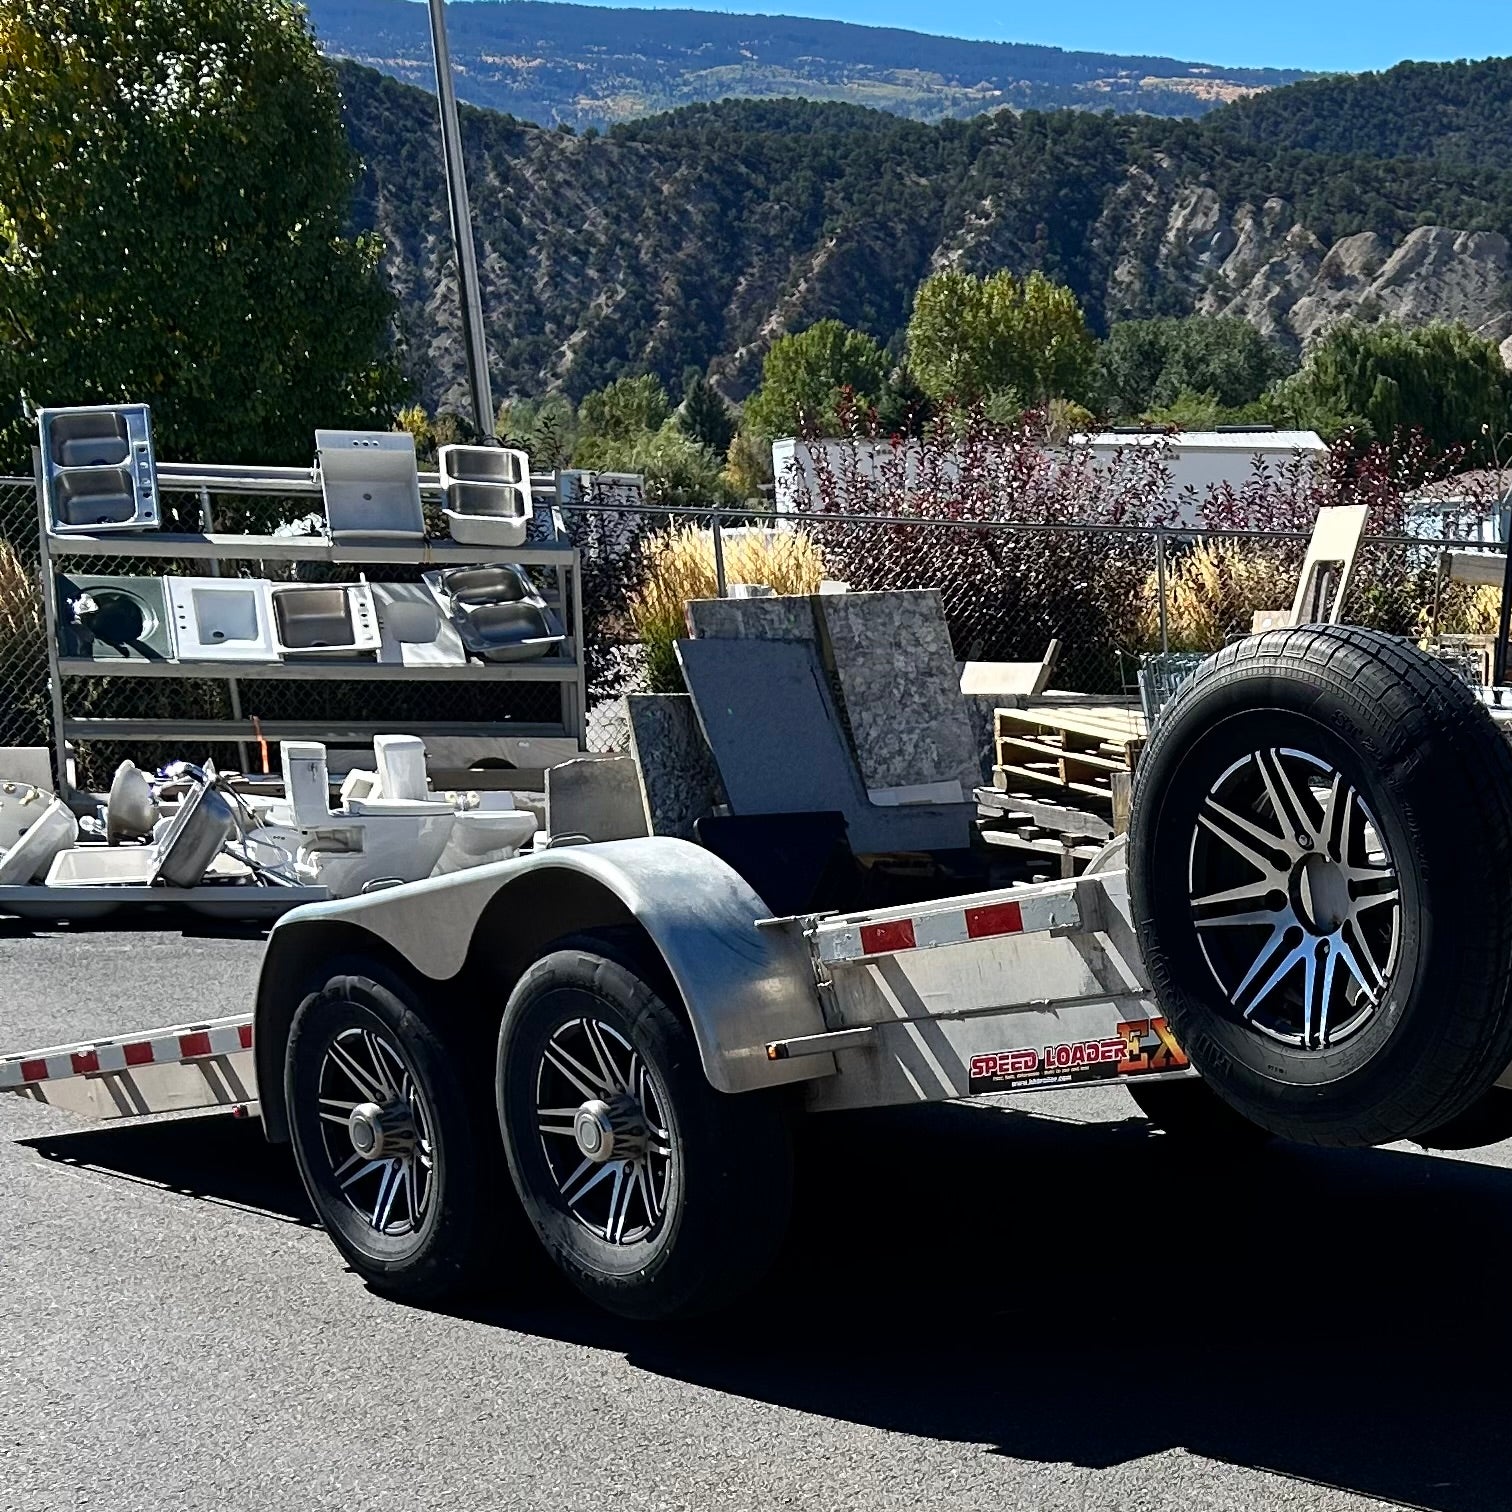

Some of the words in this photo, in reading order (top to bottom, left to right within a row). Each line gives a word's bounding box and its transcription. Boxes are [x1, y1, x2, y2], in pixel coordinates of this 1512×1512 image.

[970, 1050, 1037, 1078] SPEED
[1044, 1038, 1129, 1069] LOADER
[1117, 1017, 1189, 1073] EX
